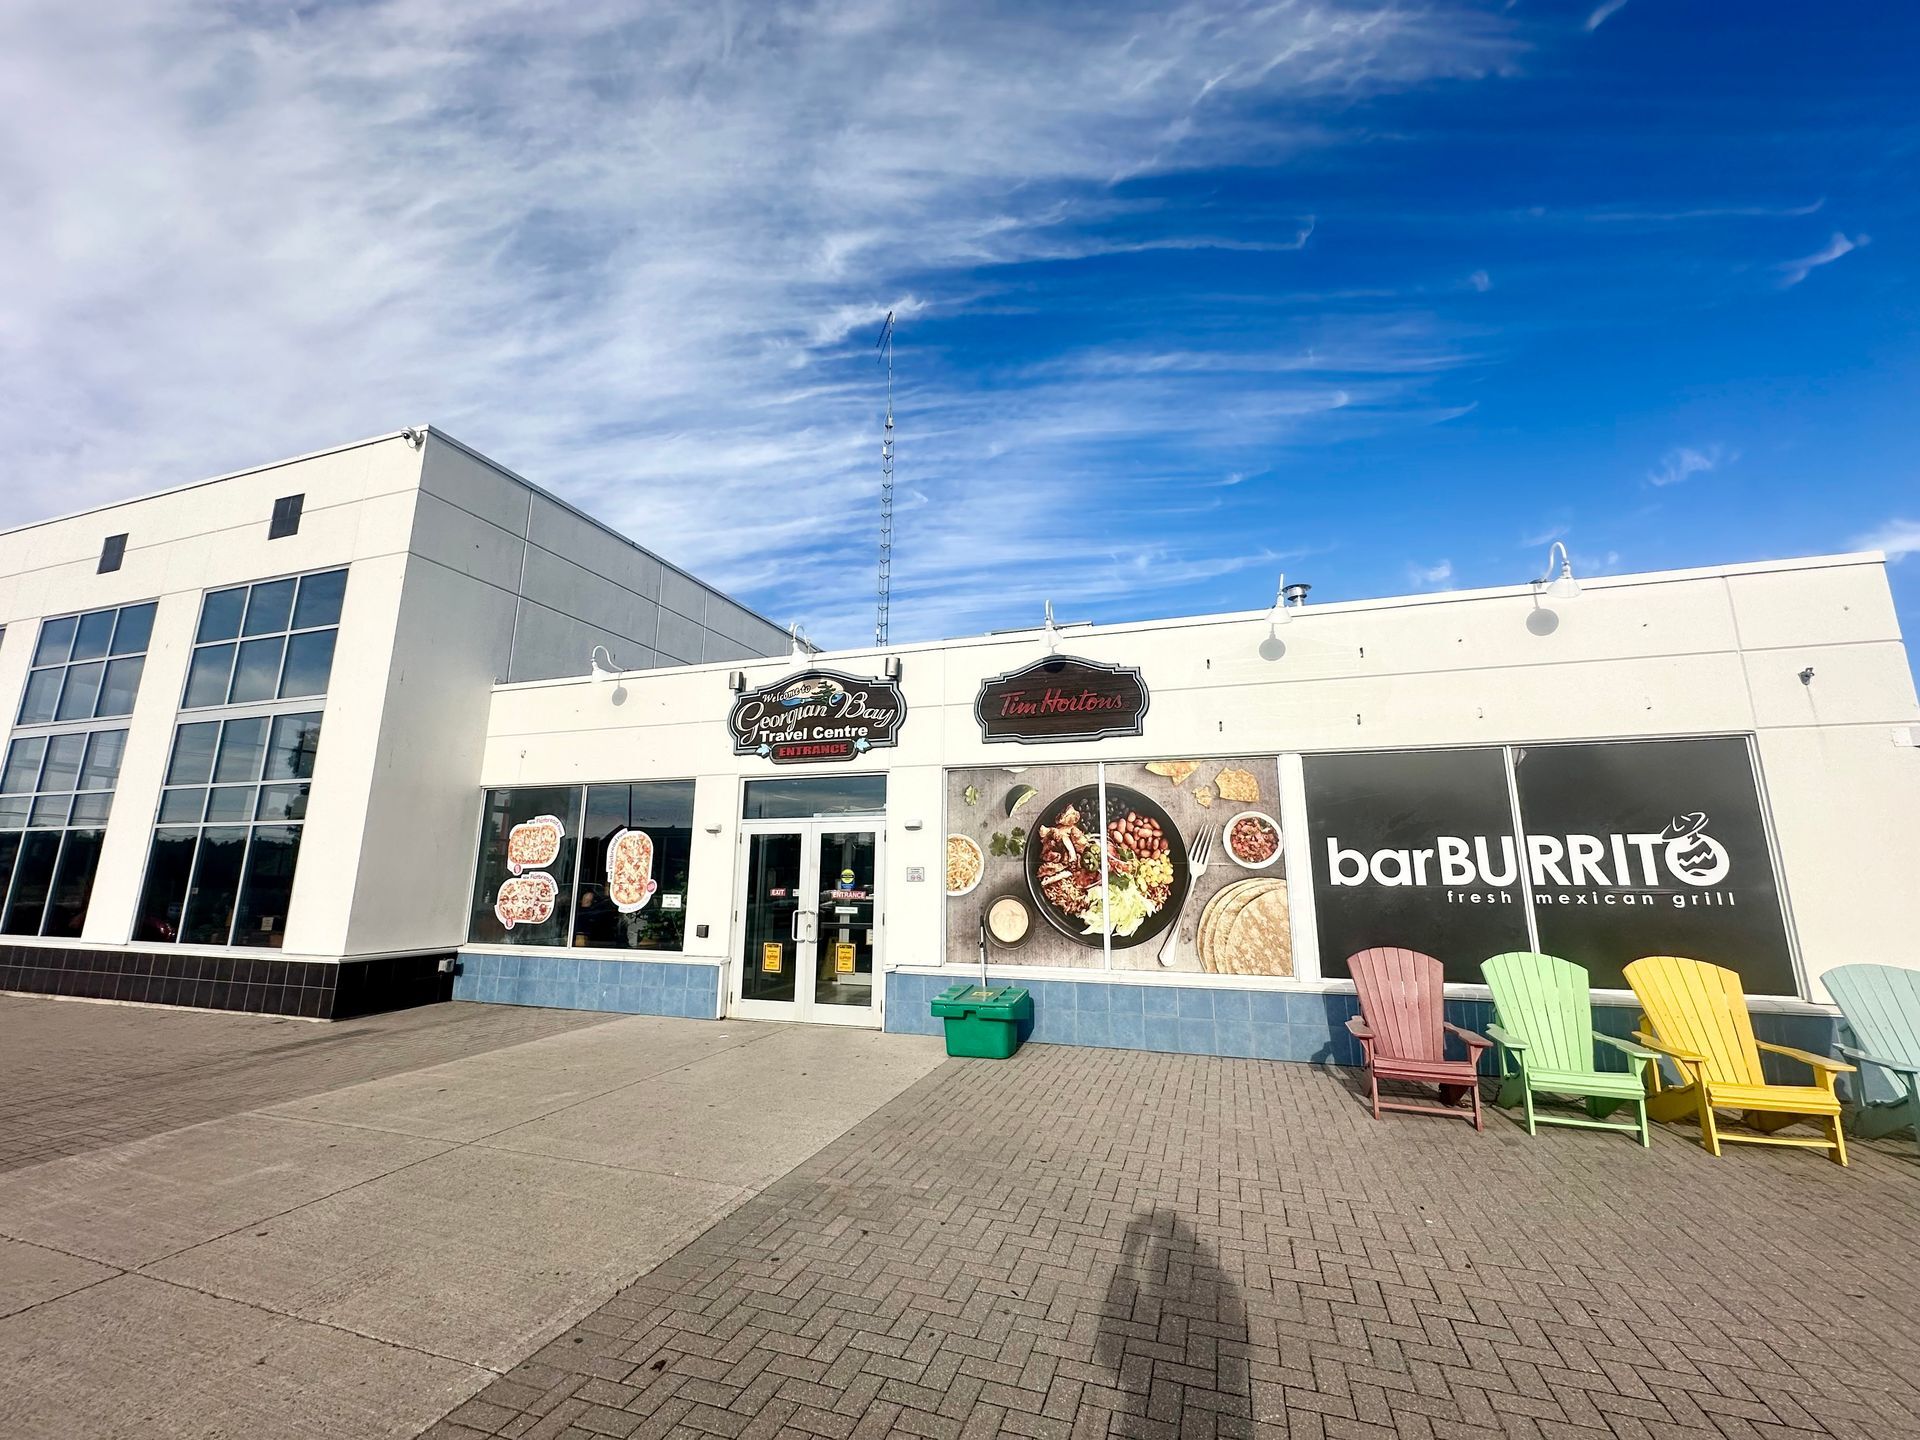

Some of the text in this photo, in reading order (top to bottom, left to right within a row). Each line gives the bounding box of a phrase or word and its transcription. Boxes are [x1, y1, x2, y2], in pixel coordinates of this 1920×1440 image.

[762, 684, 812, 704] Welcome to
[1000, 688, 1122, 717] Tim Hortons
[736, 691, 895, 746] Georgian Bay
[759, 725, 869, 743] Travel Centre
[778, 743, 848, 757] ENTRANCE
[771, 888, 785, 897] EXIT
[832, 890, 867, 899] ENTRANCE
[1447, 890, 1736, 909] fresh mexican grill
